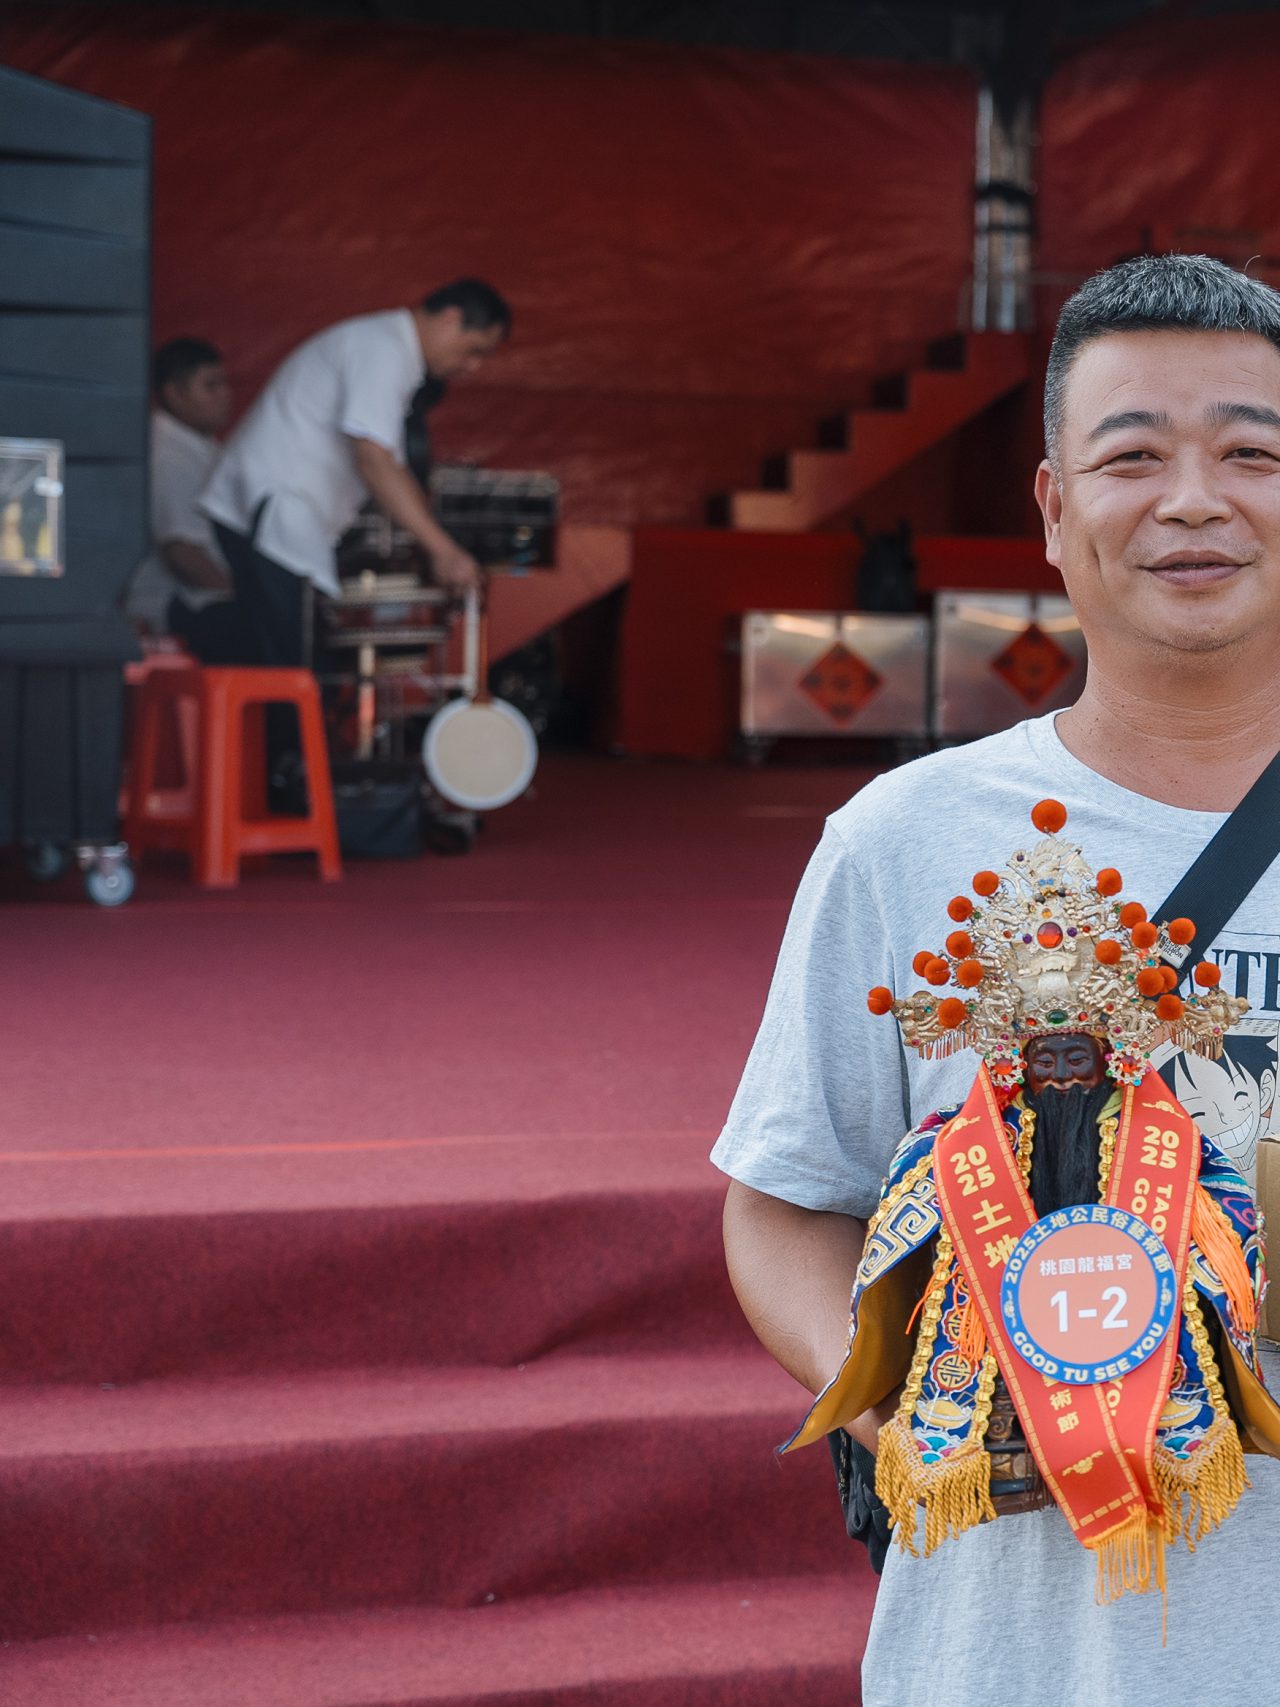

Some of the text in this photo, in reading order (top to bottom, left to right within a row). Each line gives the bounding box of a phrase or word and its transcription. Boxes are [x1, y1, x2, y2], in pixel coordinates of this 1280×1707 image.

[1131, 1178, 1151, 1220] GO
[1151, 1184, 1173, 1240] TAO
[1039, 1253, 1133, 1276] 桃園龍福宮
[1050, 1286, 1128, 1332] 1-2
[1013, 1322, 1164, 1382] GOOD TU SEE YOU
